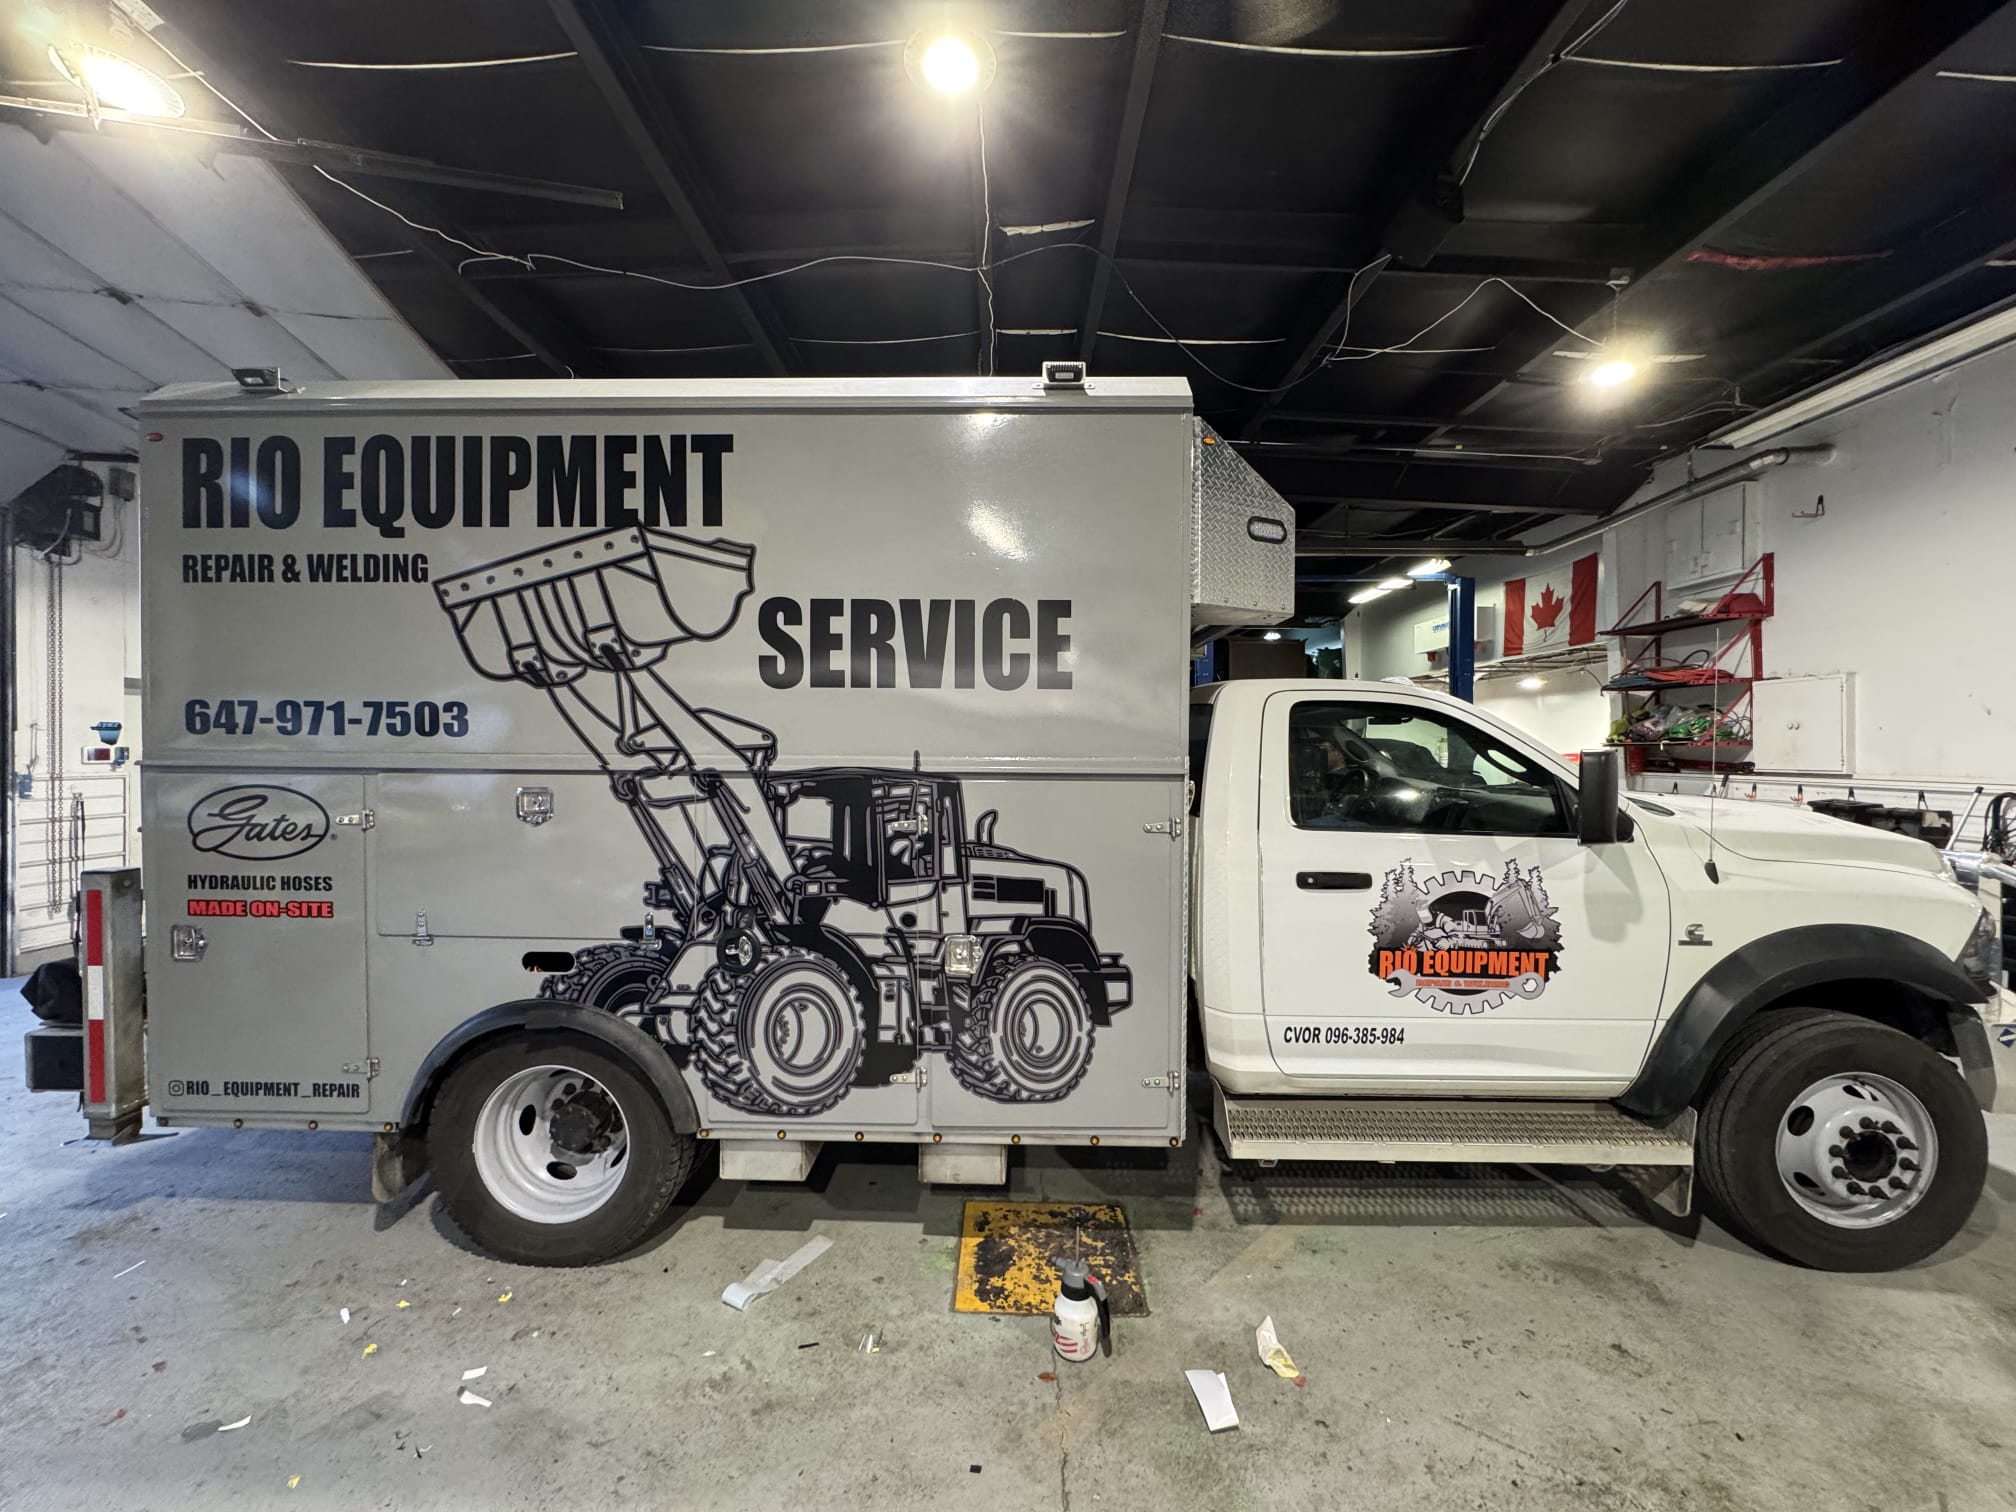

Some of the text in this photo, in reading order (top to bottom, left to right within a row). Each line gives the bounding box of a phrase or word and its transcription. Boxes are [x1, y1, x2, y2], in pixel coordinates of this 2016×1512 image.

[182, 434, 734, 538] RIO EQUIPMENT
[182, 554, 429, 583] REPAIR & WELDING
[758, 596, 1073, 691] SERVICE
[184, 699, 470, 737] 647-971-7503
[192, 794, 325, 852] Gates
[187, 874, 333, 892] HYDRAULIC HOSES
[187, 899, 334, 918] MADE ON-SITE
[1379, 949, 1550, 979] RIO EQUIPMENT
[1284, 1026, 1405, 1045] CVOR 096-385-984
